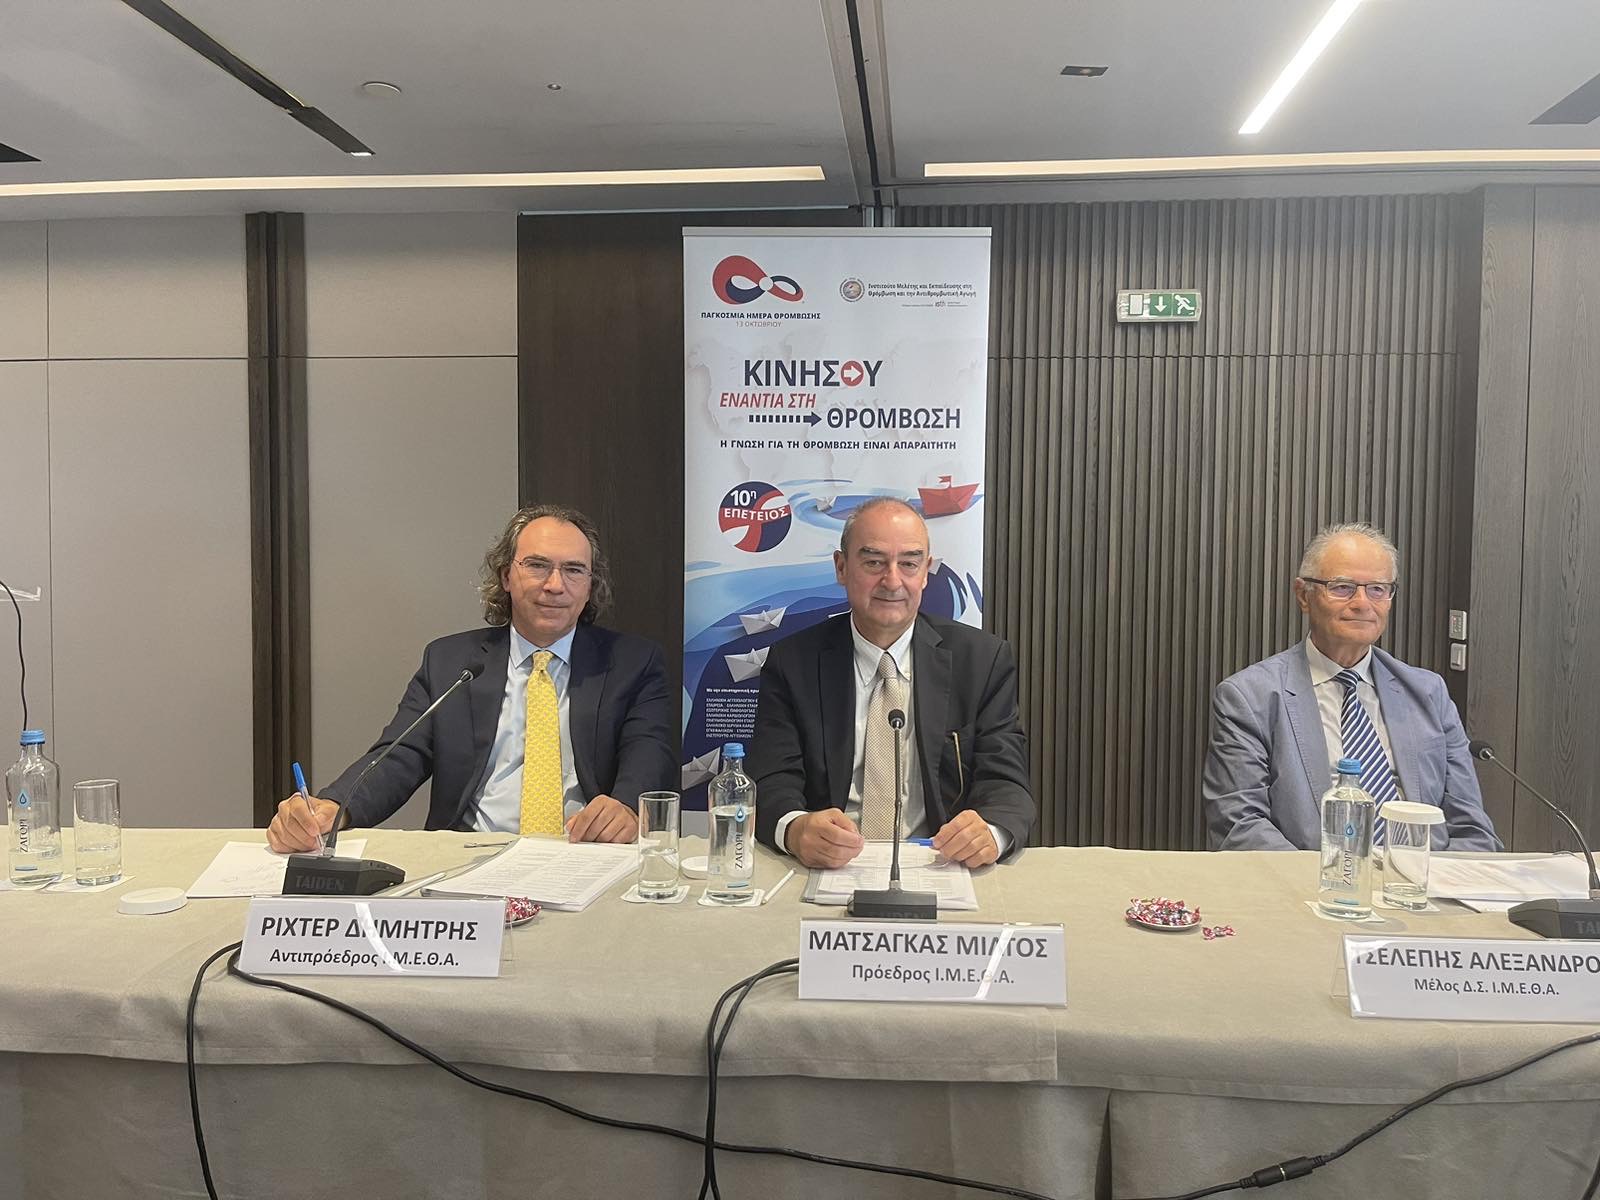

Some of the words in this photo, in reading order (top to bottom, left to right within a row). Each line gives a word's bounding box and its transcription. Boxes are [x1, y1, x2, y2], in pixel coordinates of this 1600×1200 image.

[774, 312, 821, 320] ΘΡΟΜΒΩΣΗΣ
[744, 360, 883, 387] ΚΙΝΗΣΟΥ
[719, 392, 784, 409] ΕΝΑΝΤΙΑ
[787, 393, 817, 409] ΣΤΗ
[826, 407, 961, 430] ΘΡΟΜΒΩΣΗ
[720, 440, 727, 448] Η
[731, 440, 764, 449] ΓΝΩΣΗ
[768, 440, 783, 449] ΓΙΑ
[787, 440, 800, 449] ΤΗ
[803, 440, 860, 449] ΘΡΟΜΒΩΣΗ
[864, 441, 890, 449] ΕΙΝΑΙ
[893, 441, 957, 450] ΑΠΑΡΑΙΤΗΤΗ
[729, 489, 757, 507] 10η
[724, 506, 788, 521] ΕΠΕΤΕΙΟΣ
[295, 875, 345, 891] TAIDEN
[261, 917, 340, 937] ΡΙΧΤΕΡ
[809, 930, 948, 955] ΜΑΤΣΑΓΚΑΣ
[269, 949, 378, 967] Αντιπρόεδρος
[382, 951, 459, 966] Μ.Ε.Θ.Α.
[852, 964, 930, 983] Πρόεδρος
[1414, 978, 1459, 994] Μέλος
[1463, 980, 1489, 993] Δ.Σ.
[1493, 981, 1560, 996] Ι.Μ.Ε.Θ.Α.
